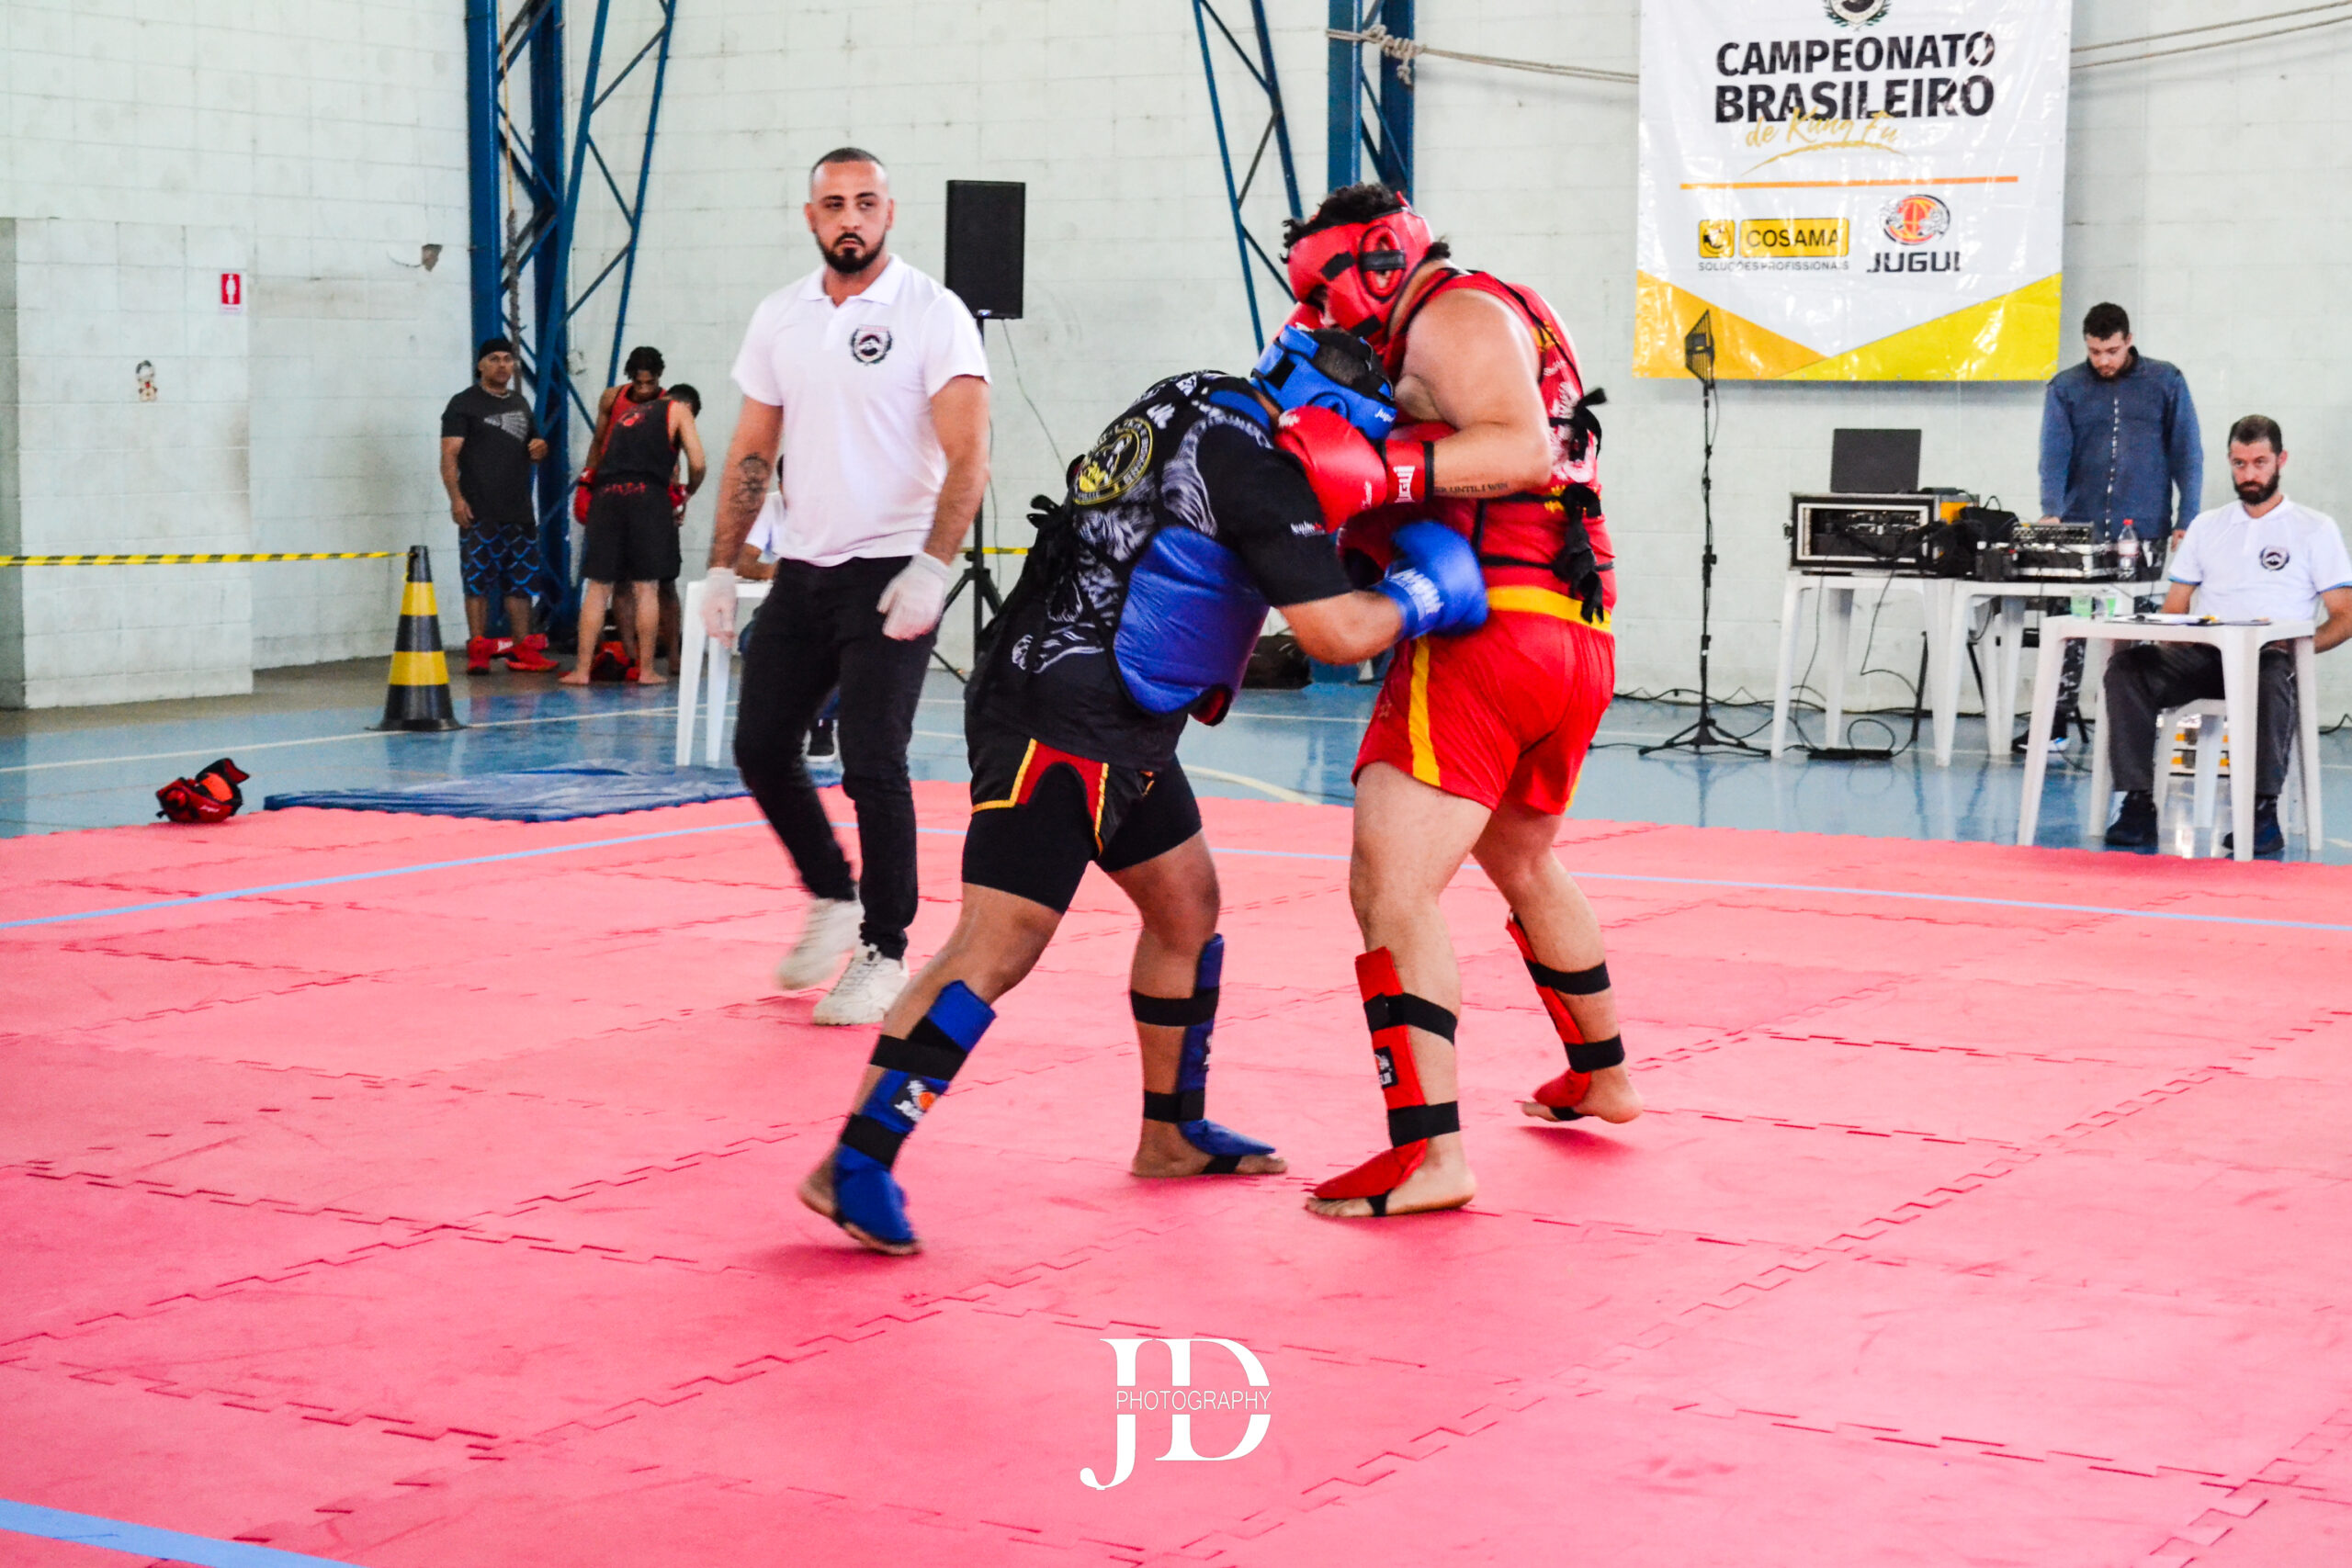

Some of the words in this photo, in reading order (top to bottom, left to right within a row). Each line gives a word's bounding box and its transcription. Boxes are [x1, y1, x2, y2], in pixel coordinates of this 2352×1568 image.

[1716, 31, 1996, 76] CAMPEONATO
[1715, 74, 1995, 123] BRASILEIRO
[1746, 116, 1780, 148] de
[1785, 106, 1856, 145] Kung
[1862, 109, 1900, 144] Fu
[1747, 229, 1839, 248] COSAMA
[1761, 260, 1849, 271] PROFISSIONAS
[1866, 251, 1961, 273] JUGUI
